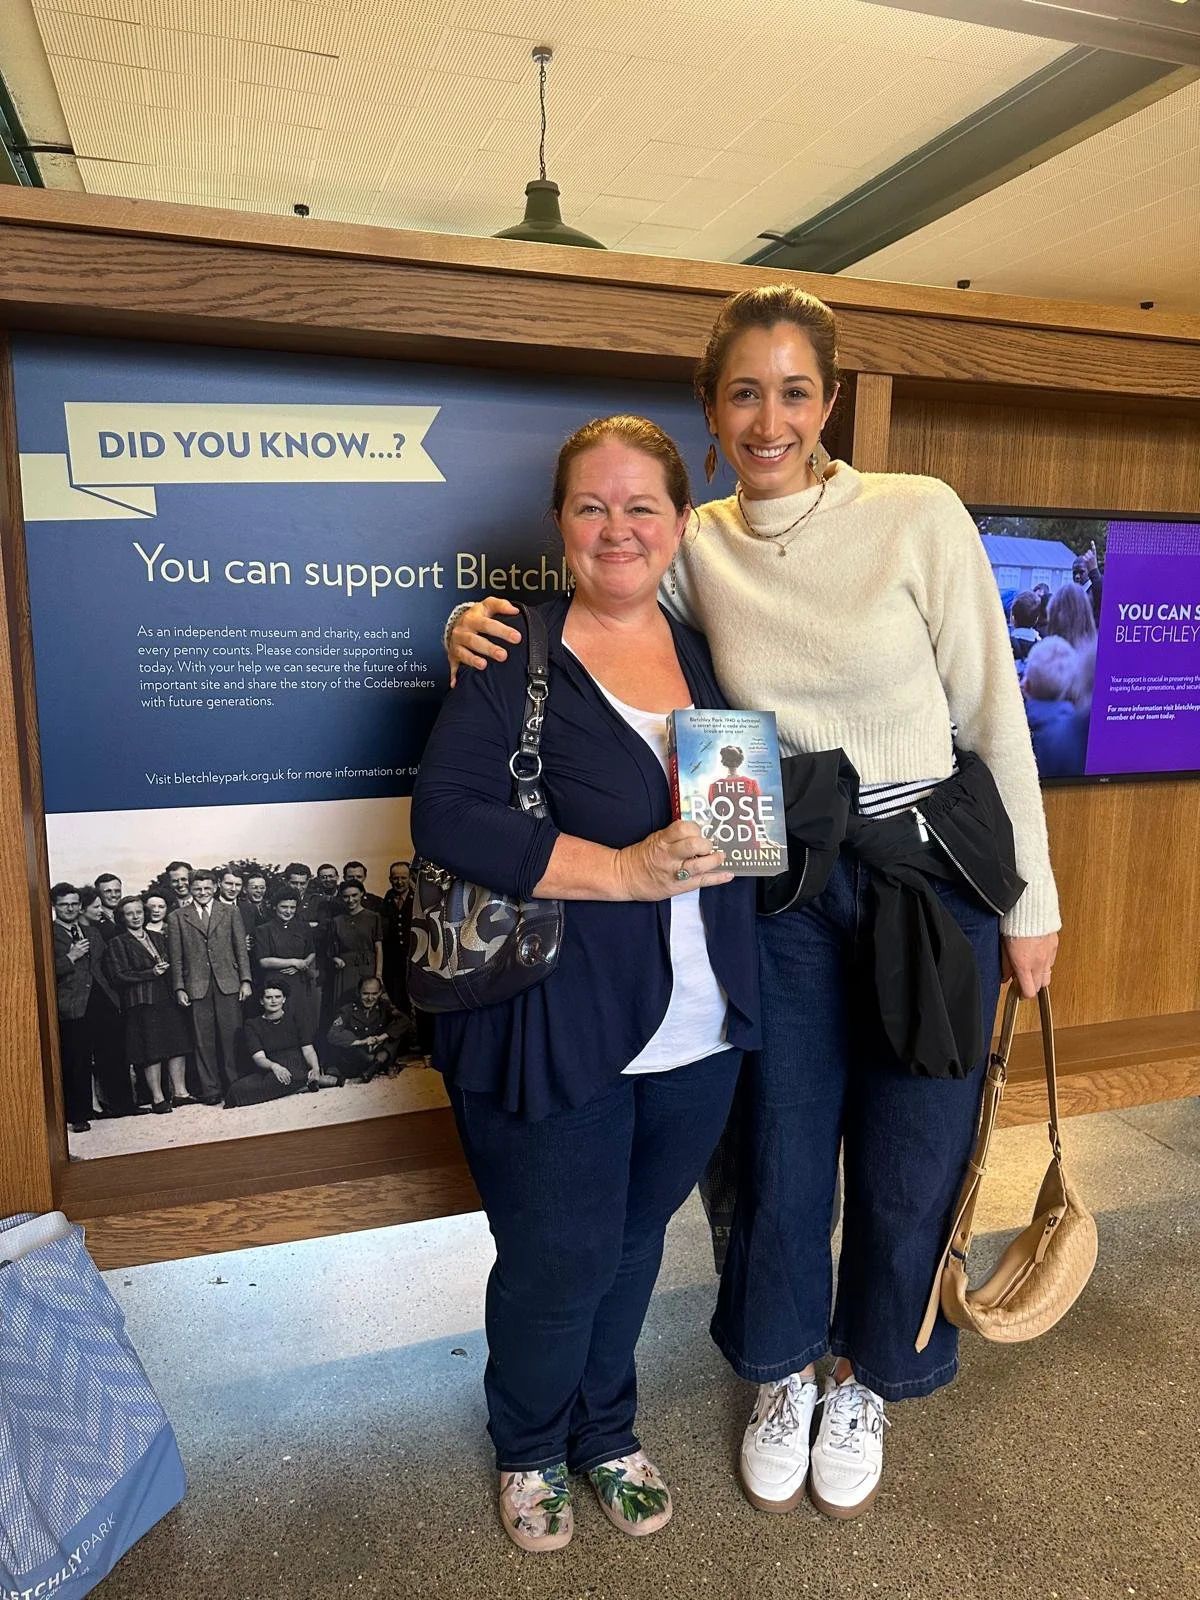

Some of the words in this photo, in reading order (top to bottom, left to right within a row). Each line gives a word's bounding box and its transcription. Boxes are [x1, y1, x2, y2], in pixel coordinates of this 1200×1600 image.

[99, 431, 165, 458] DID
[173, 431, 250, 458] YOU
[260, 431, 406, 458] KNOW...?
[133, 542, 210, 583] You
[225, 560, 291, 585] can
[304, 560, 444, 597] support
[1118, 603, 1154, 620] YOU
[1157, 603, 1191, 620] CAN
[137, 625, 153, 637] As
[156, 628, 171, 637] an
[174, 625, 248, 640] independent
[250, 628, 298, 638] museum
[300, 627, 321, 638] and
[324, 627, 361, 641] charity,
[364, 628, 389, 639] each
[391, 628, 410, 639] and
[1115, 625, 1200, 643] BLETCHLEY
[138, 647, 171, 658] every
[174, 647, 210, 658] penny
[212, 645, 253, 655] counts.
[256, 643, 292, 656] Please
[295, 644, 341, 656] consider
[343, 645, 399, 658] supporting
[402, 647, 413, 656] us
[139, 661, 175, 675] today.
[177, 660, 206, 672] With
[209, 664, 235, 675] your
[237, 661, 262, 675] help
[264, 664, 281, 672] we
[283, 664, 303, 672] can
[306, 663, 341, 672] secure
[344, 661, 360, 672] the
[363, 661, 394, 672] future
[396, 661, 408, 672] of
[410, 661, 427, 672] this
[140, 679, 198, 692] important
[201, 680, 220, 690] site
[223, 677, 244, 689] and
[247, 678, 277, 689] share
[280, 678, 297, 689] the
[301, 679, 327, 692] story
[330, 677, 342, 689] of
[344, 677, 361, 689] the
[364, 676, 435, 689] Codebreakers
[1111, 675, 1122, 683] Your
[1123, 676, 1141, 684] support
[1147, 675, 1163, 683] crucial
[1169, 675, 1194, 684] preserving
[1109, 685, 1131, 693] inspiring
[1131, 684, 1146, 692] future
[141, 696, 165, 708] with
[168, 695, 203, 707] future
[206, 696, 275, 709] generations.
[1132, 704, 1162, 712] information
[1106, 713, 1129, 721] member
[145, 772, 171, 785] Visit
[174, 768, 284, 785] bletchleypark.org.uk
[287, 768, 302, 780] for
[304, 769, 332, 779] more
[335, 766, 393, 778] information
[395, 767, 406, 776] or
[716, 781, 746, 793] THE
[691, 796, 776, 821] ROSE
[701, 824, 770, 842] CODE
[731, 849, 781, 861] QUINN
